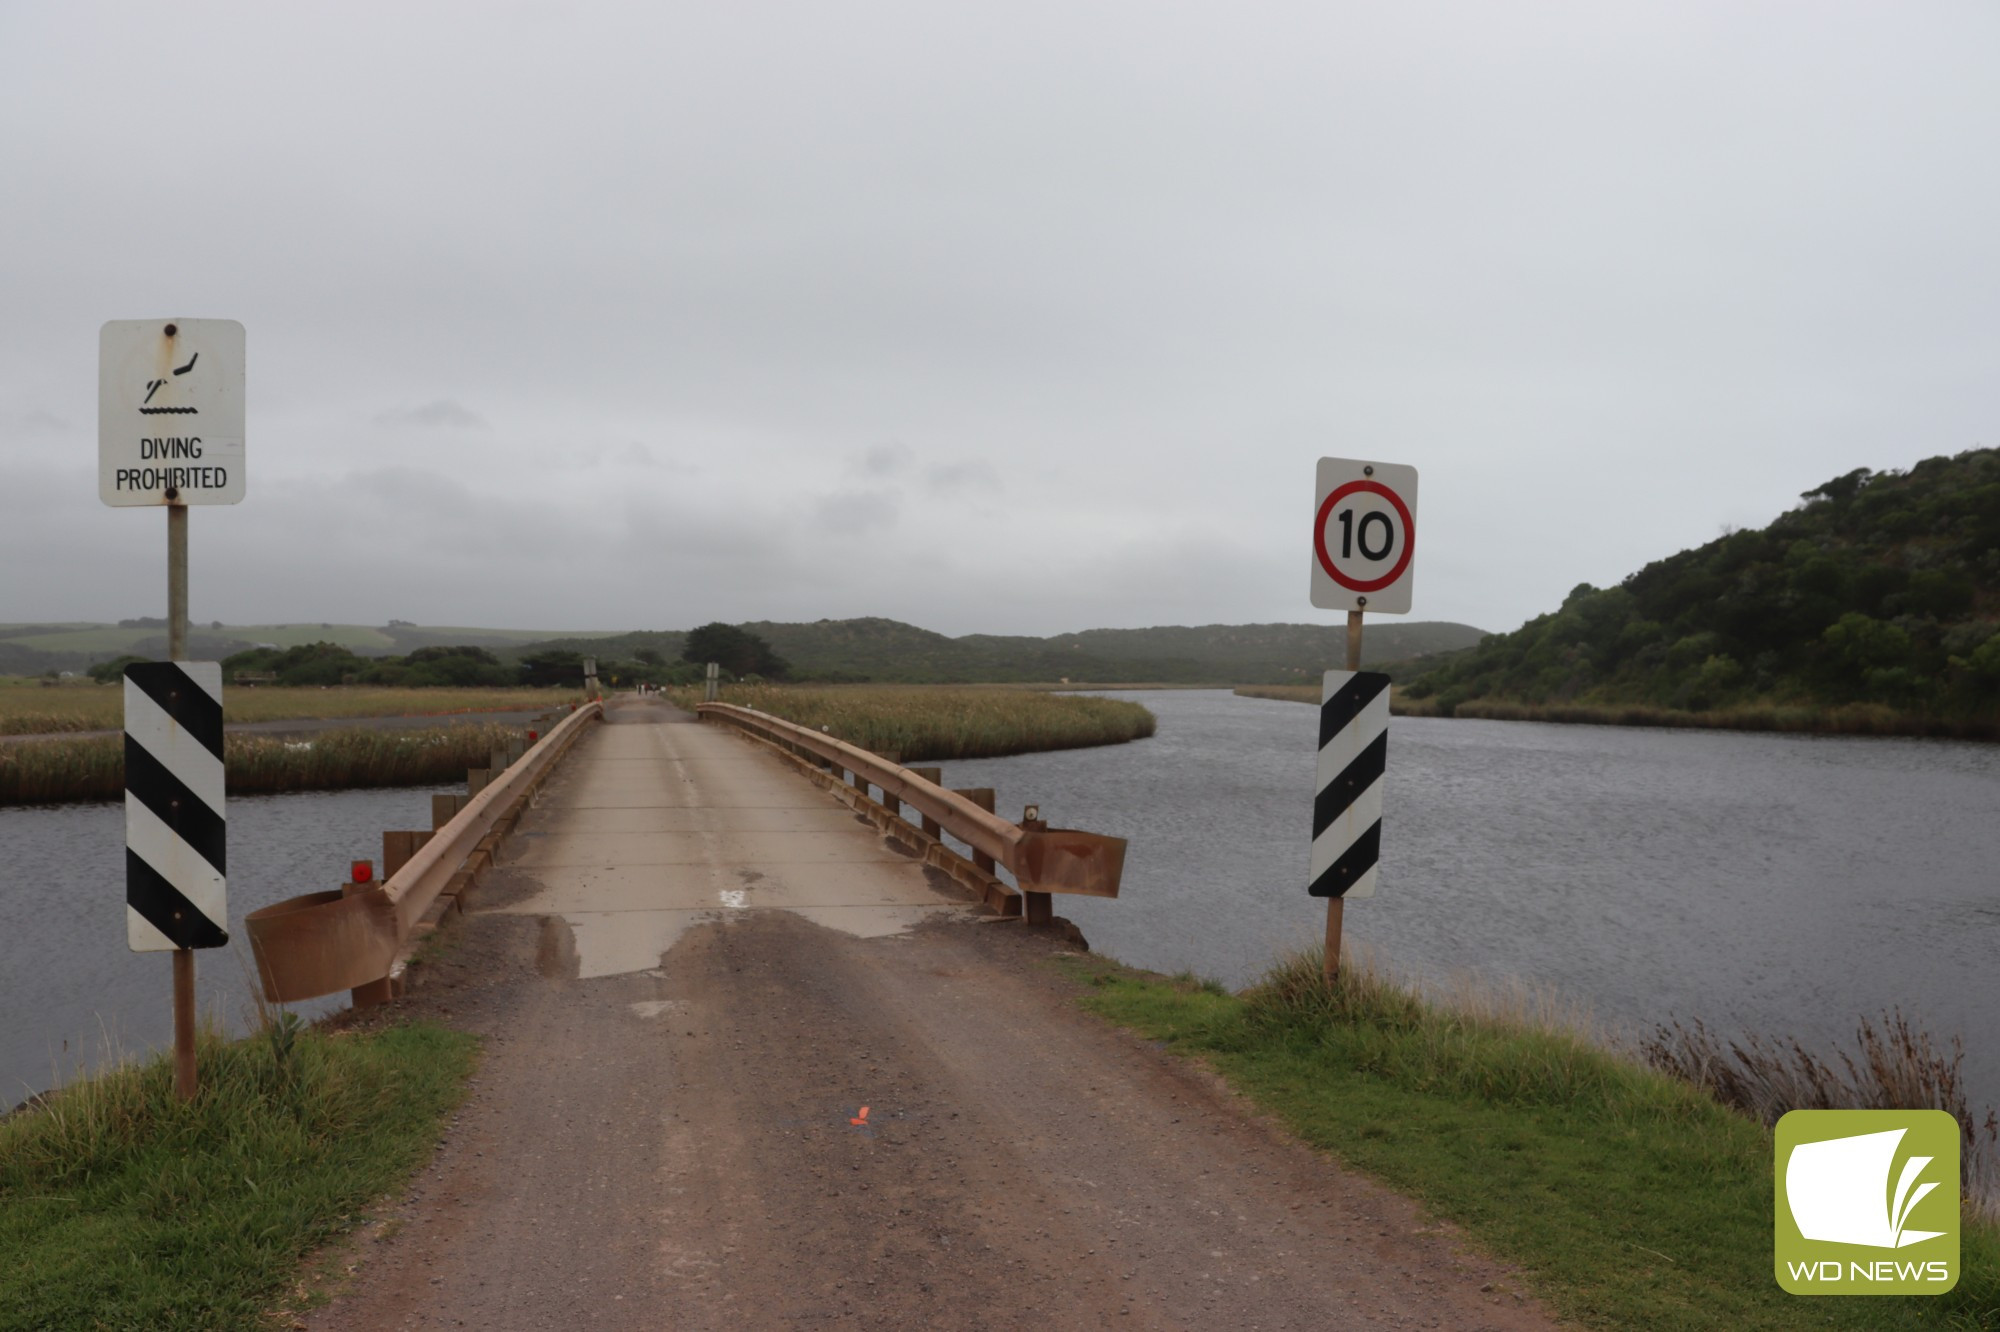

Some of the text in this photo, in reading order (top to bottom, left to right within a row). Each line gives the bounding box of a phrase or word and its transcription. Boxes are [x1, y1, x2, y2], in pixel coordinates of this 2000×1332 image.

[141, 437, 202, 460] DIVING
[116, 467, 227, 490] PROHIBITED
[1338, 509, 1394, 561] 10
